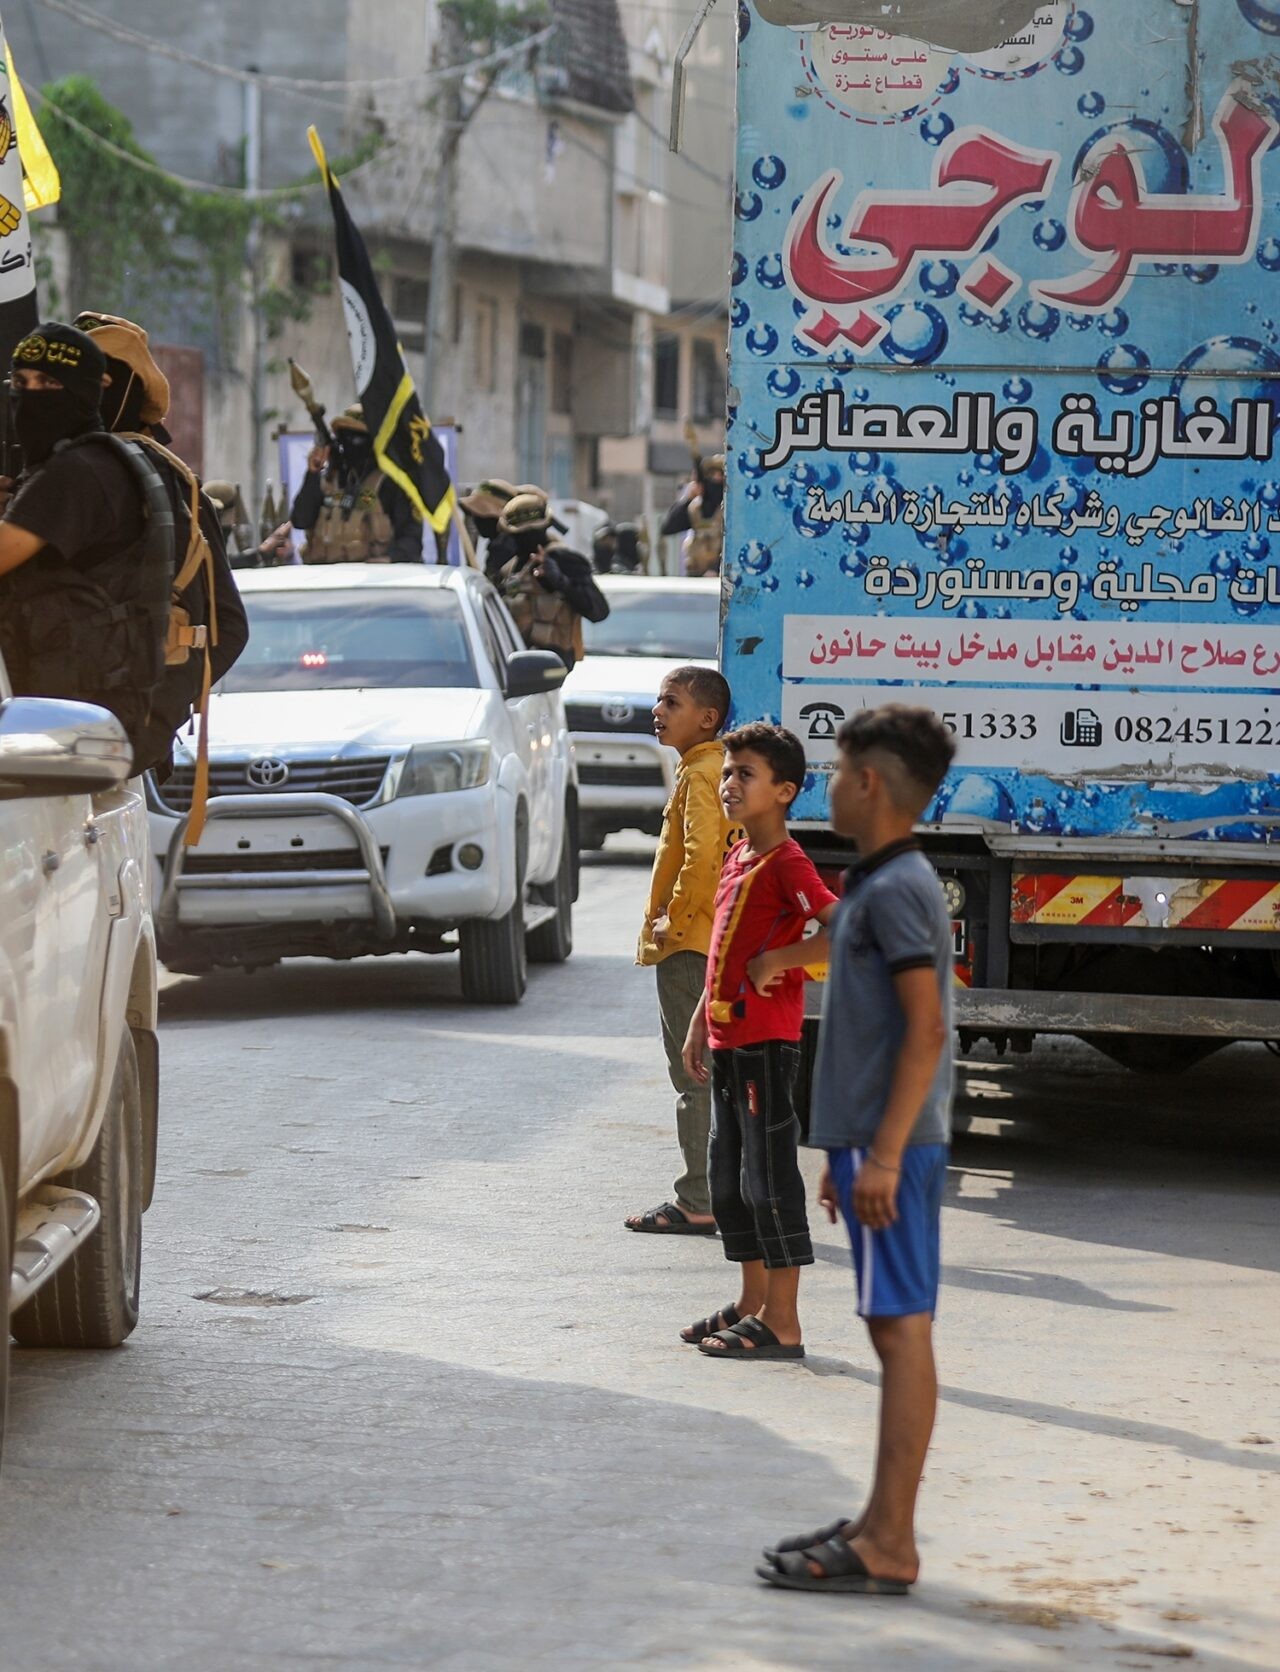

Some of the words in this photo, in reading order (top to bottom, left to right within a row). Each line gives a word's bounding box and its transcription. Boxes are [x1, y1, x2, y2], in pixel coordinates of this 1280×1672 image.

[1032, 14, 1053, 28] في
[835, 73, 871, 92] غزة
[875, 75, 923, 93] قطاع
[759, 389, 1039, 476] والعصائر
[1052, 393, 1273, 477] الغازية
[807, 485, 897, 525] العامة
[902, 490, 1010, 534] للتجارة
[1015, 489, 1121, 537] وشركاه
[1124, 496, 1262, 546] الفالوجي
[864, 556, 1080, 612] ومستوردة
[1092, 561, 1217, 612] محلية
[809, 628, 887, 665] حانون
[894, 633, 942, 670] بيت
[947, 632, 1018, 667] مدخل
[1024, 633, 1096, 672] مقابل
[1103, 637, 1173, 674] الدين
[1180, 638, 1247, 674] صلاح
[932, 711, 1037, 740] 51333
[1070, 896, 1084, 905] 3M
